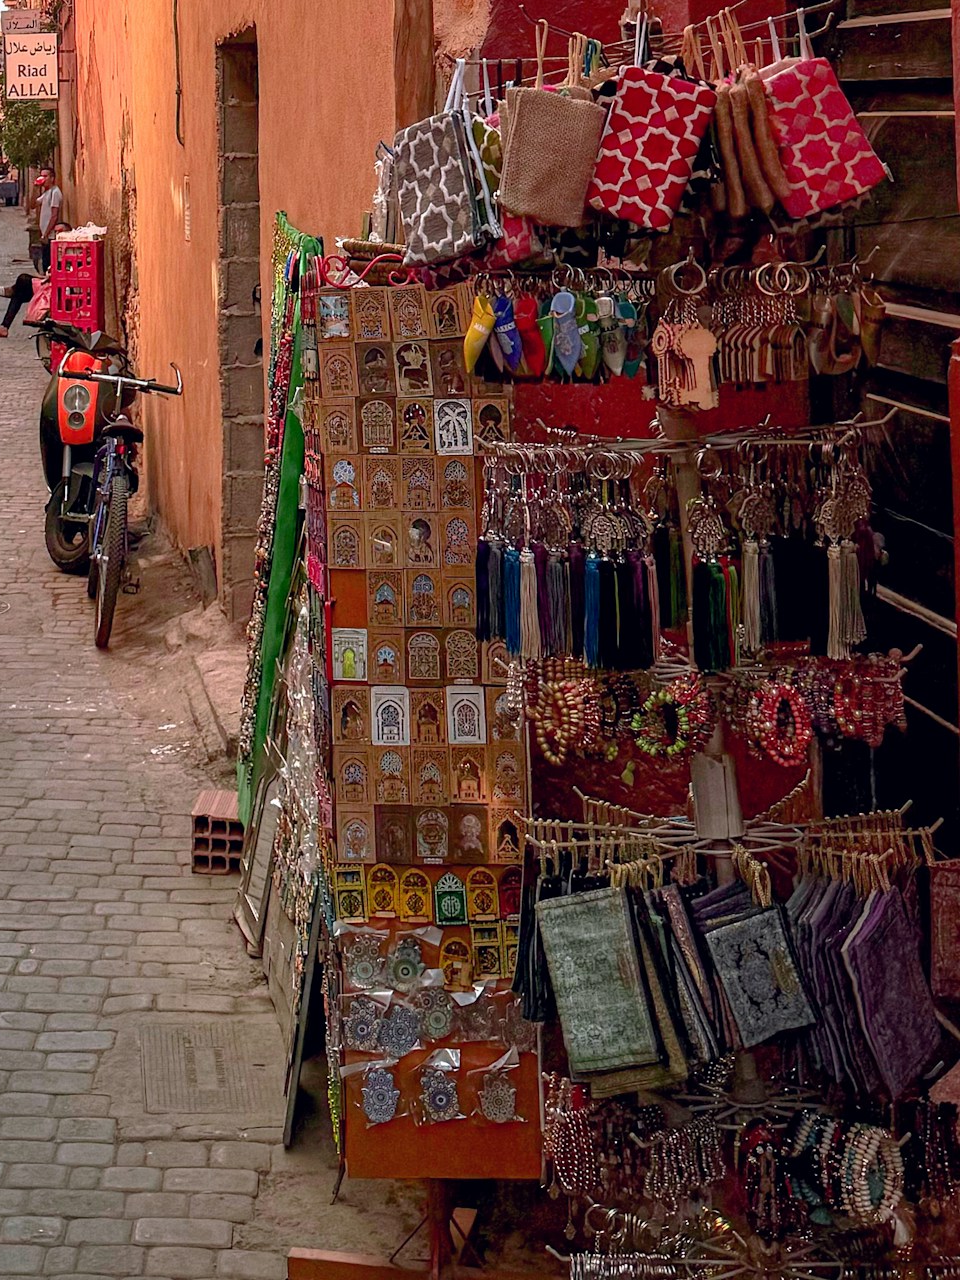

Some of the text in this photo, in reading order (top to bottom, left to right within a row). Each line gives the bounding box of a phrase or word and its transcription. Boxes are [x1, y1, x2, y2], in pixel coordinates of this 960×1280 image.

[5, 41, 56, 56] رياض علال
[17, 64, 47, 78] Riad
[8, 82, 57, 98] ALLAL
